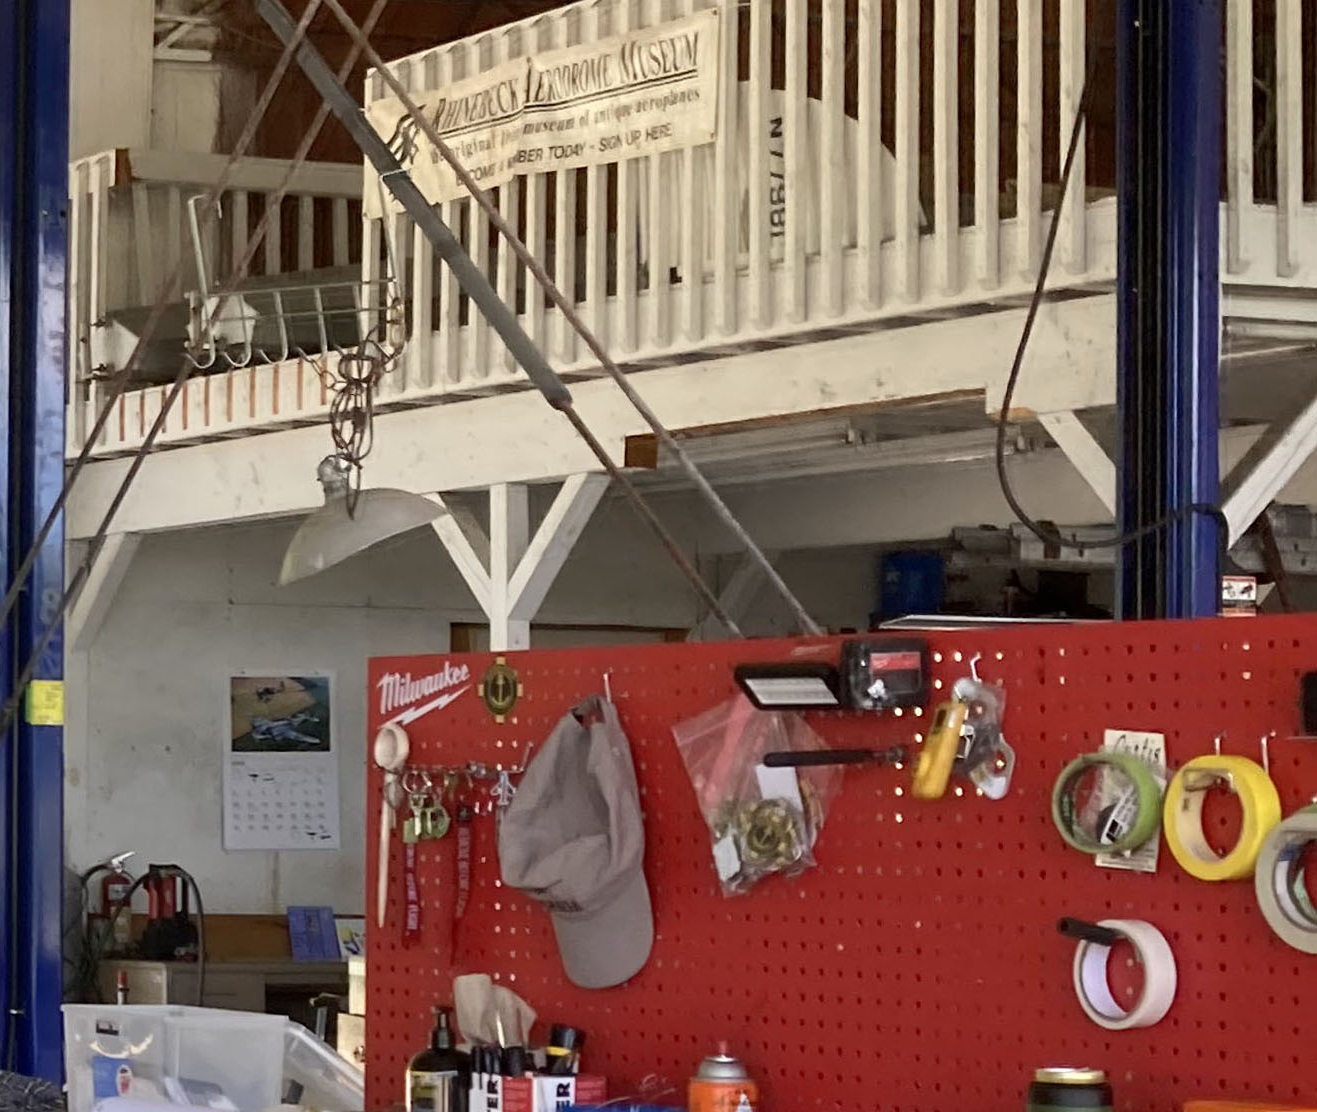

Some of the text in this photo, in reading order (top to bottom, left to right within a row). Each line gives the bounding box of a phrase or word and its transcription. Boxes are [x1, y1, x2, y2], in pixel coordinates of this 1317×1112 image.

[619, 31, 699, 84] MUSEUM
[522, 116, 575, 136] museum
[549, 140, 587, 160] TODAY
[599, 134, 623, 153] SIGN
[626, 129, 642, 148] UP
[646, 121, 673, 143] HERE
[376, 660, 471, 715] Milwaukee
